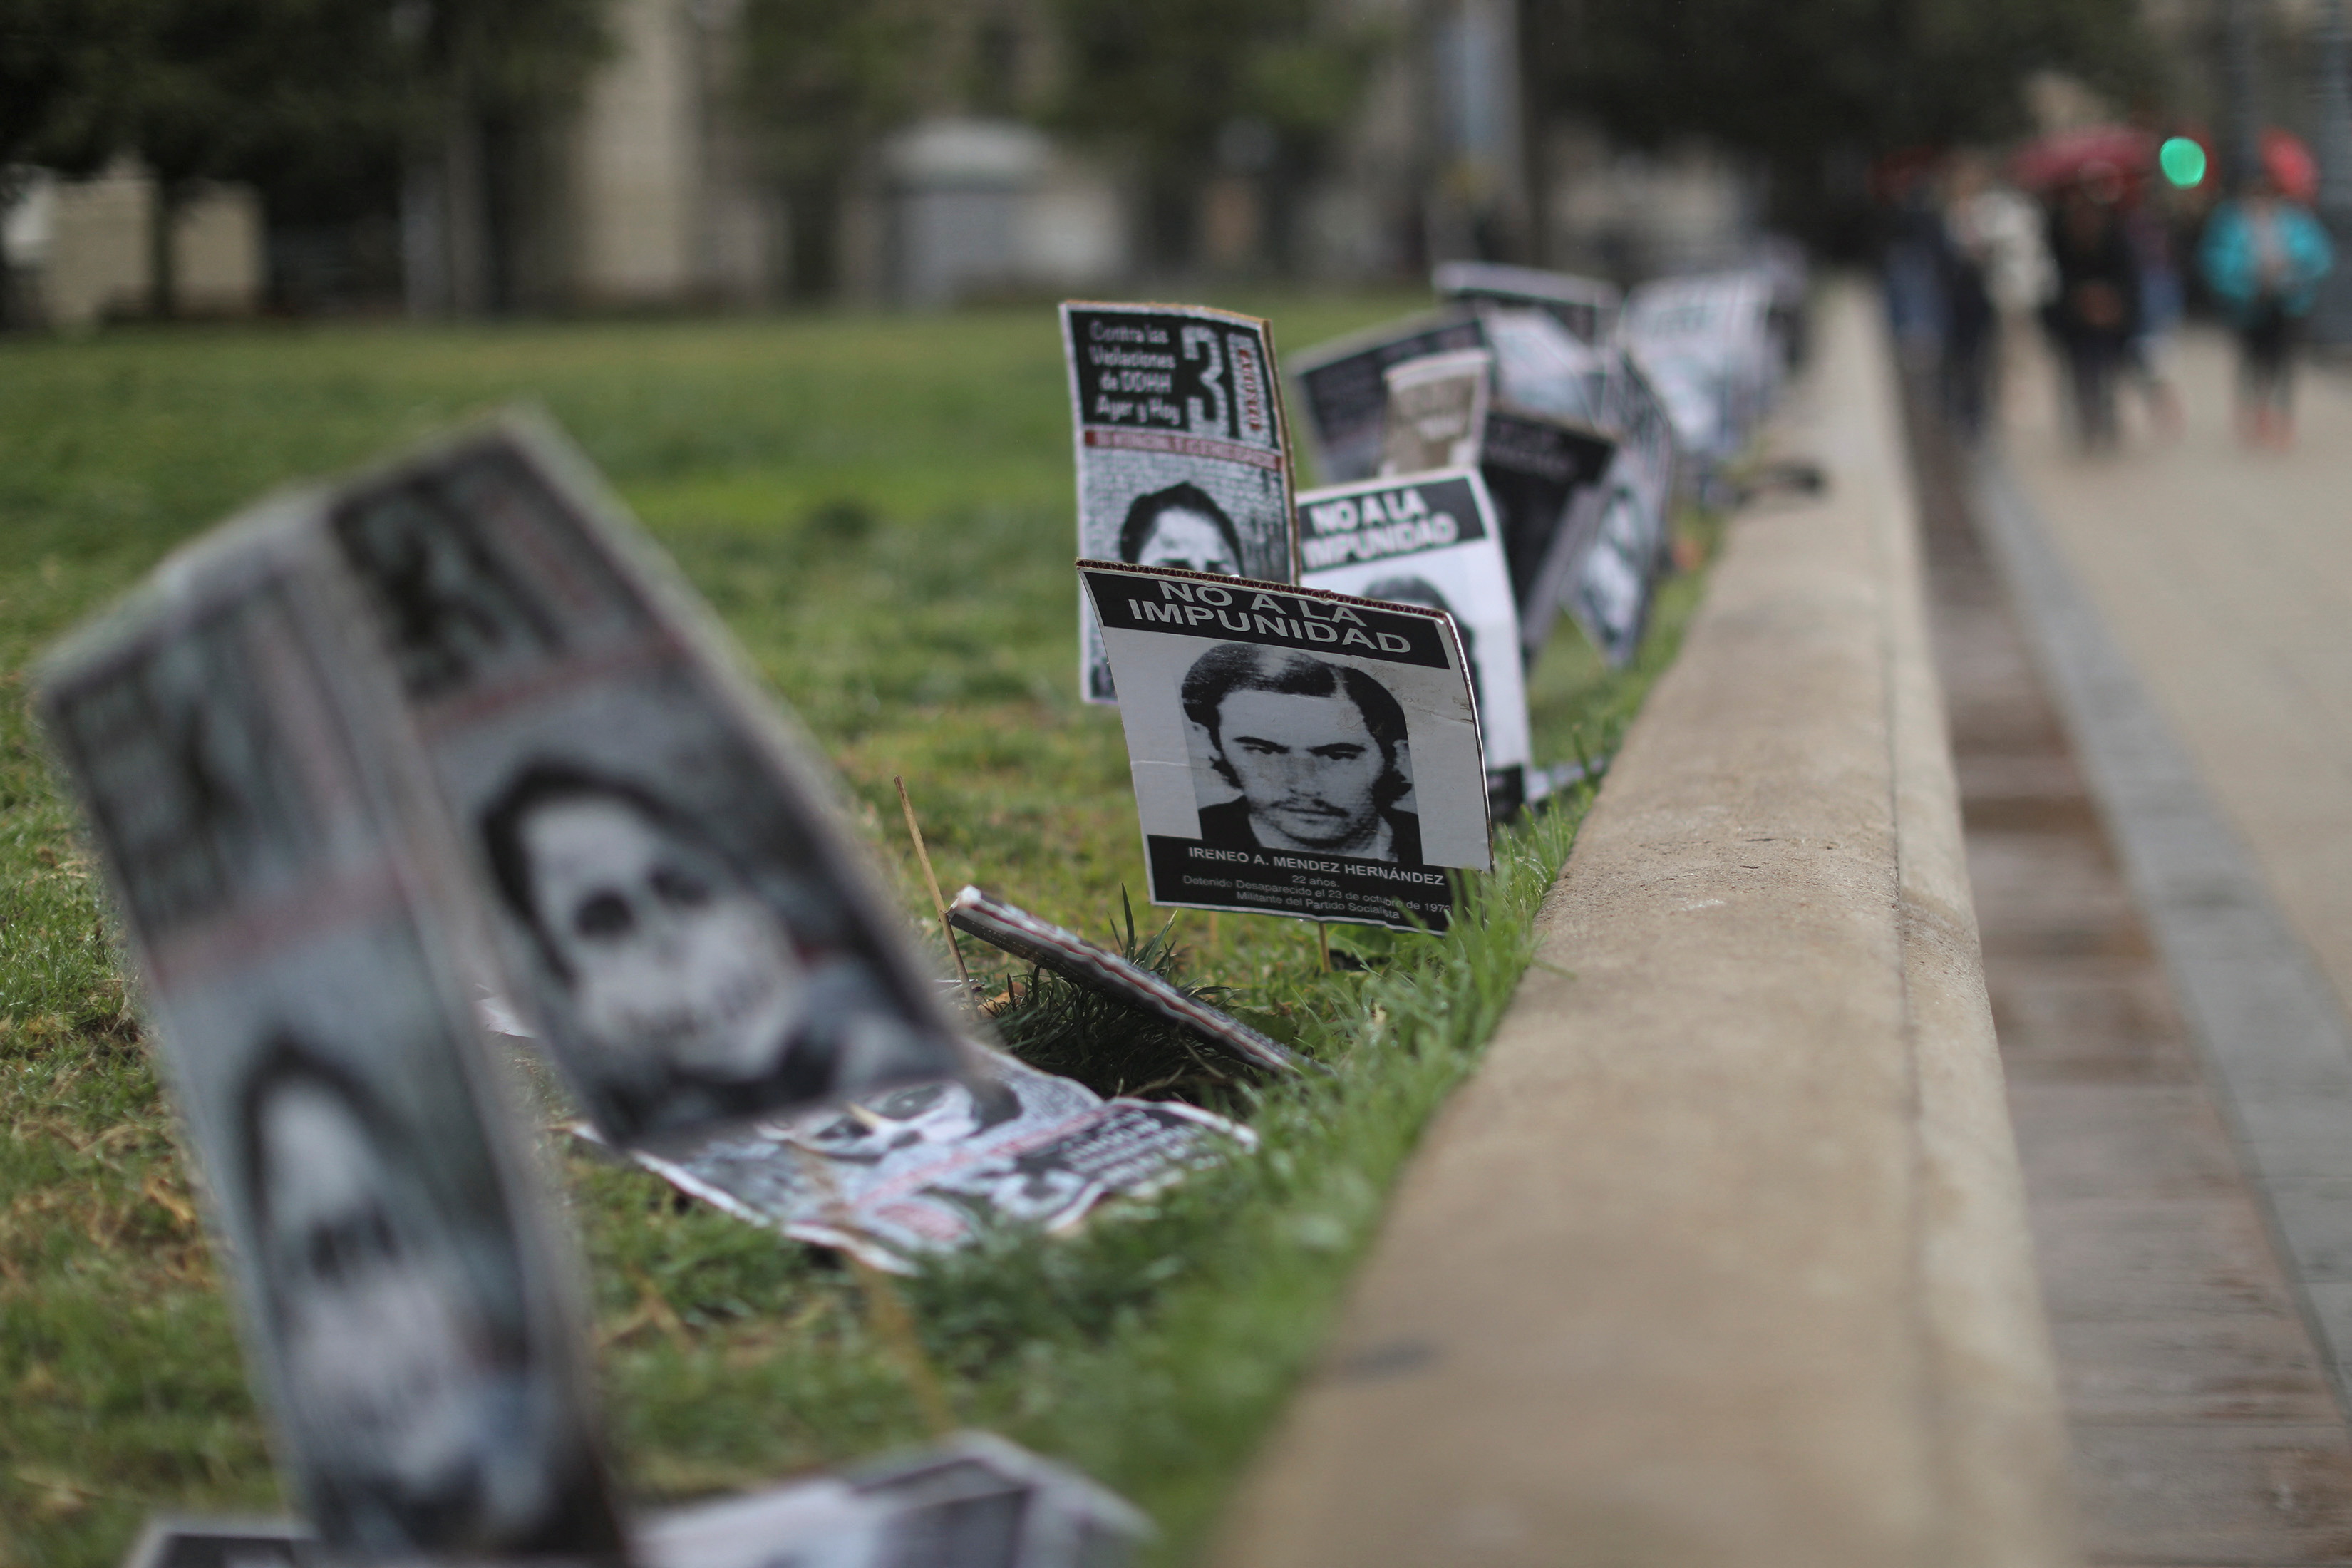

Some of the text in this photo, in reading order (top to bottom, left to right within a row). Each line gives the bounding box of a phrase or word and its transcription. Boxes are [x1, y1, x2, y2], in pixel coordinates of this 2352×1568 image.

[1089, 321, 1145, 342] Contra
[1146, 323, 1170, 344] las
[1088, 346, 1176, 370] Violaciones
[1100, 371, 1172, 393] de DDHH
[1095, 395, 1182, 425] Ayer y Hoy
[1309, 487, 1428, 535] NO A LA
[1302, 511, 1459, 569] IMPUNIDAD
[1158, 580, 1368, 627] NO A LA
[1128, 599, 1412, 654] IMPUNIDAD
[1189, 847, 1445, 886] IRENEO A. MENDEZ HERNÁNDEZ
[1291, 875, 1340, 888] 22 años.
[1183, 875, 1233, 888] Detenido
[1235, 880, 1312, 897] Desaparecido
[1315, 889, 1325, 898] el
[1328, 889, 1342, 899] 23
[1346, 892, 1360, 901] de
[1362, 895, 1403, 907] octubre
[1406, 900, 1420, 910] de
[1236, 891, 1401, 919] Militante del Partido Socialista
